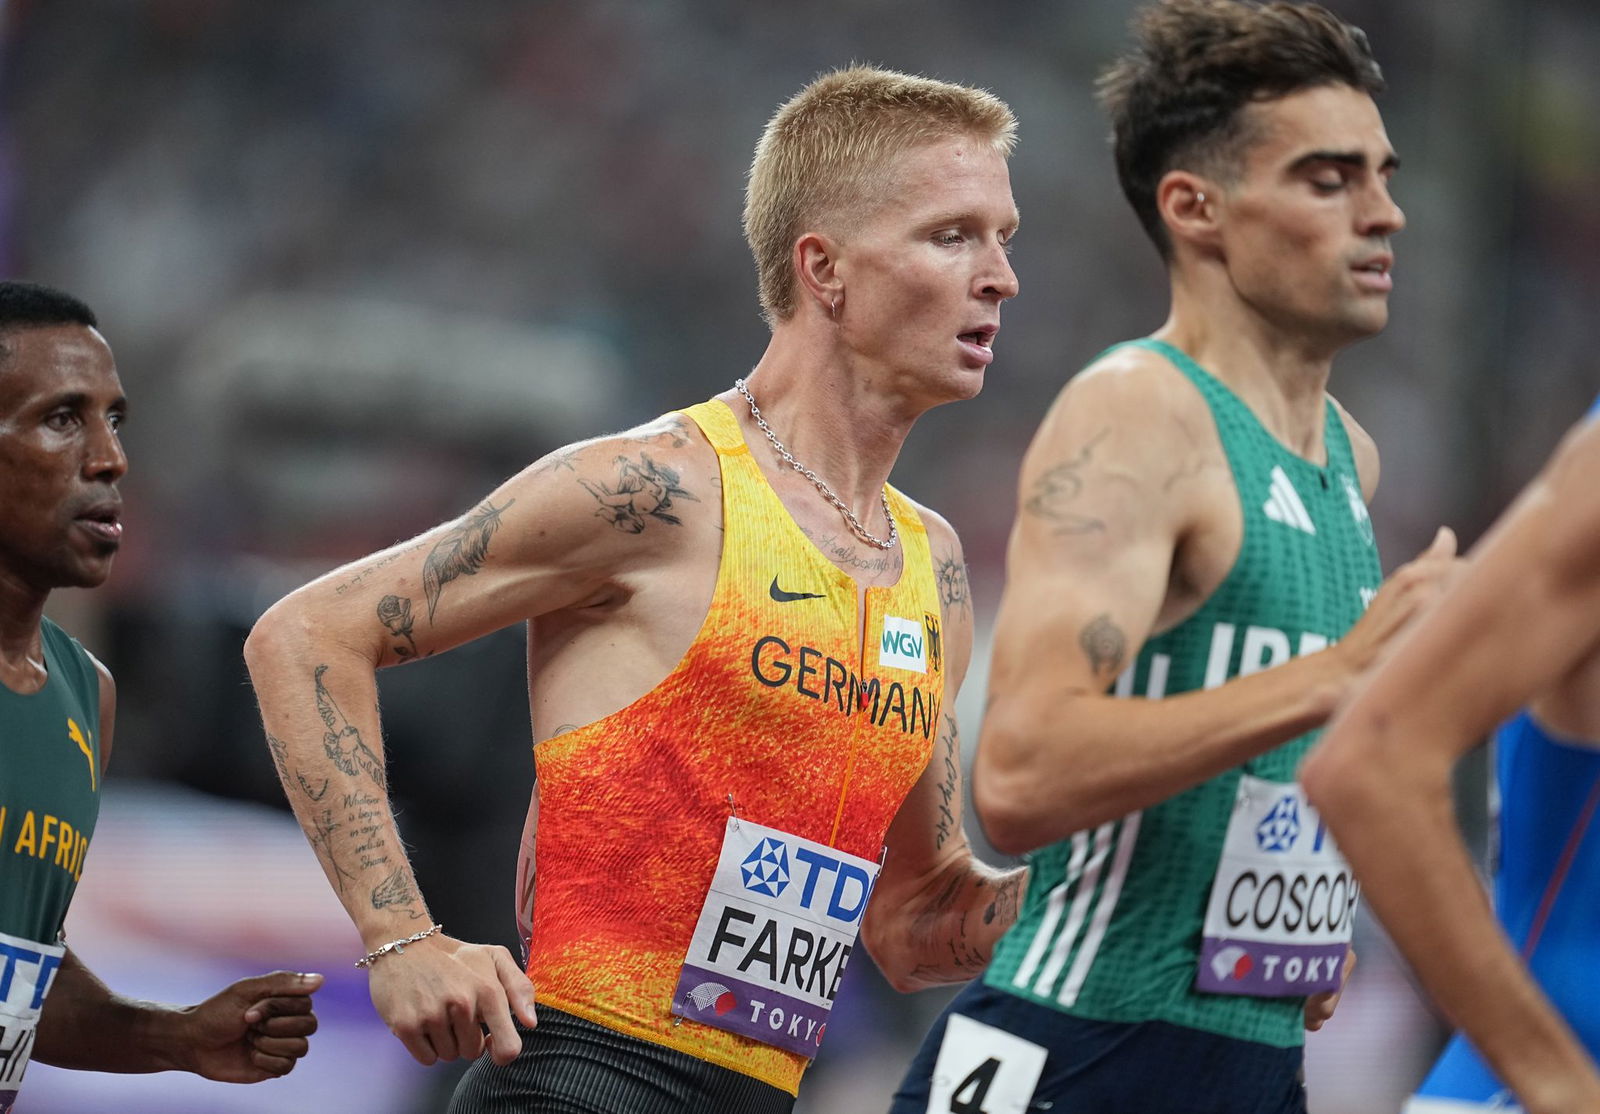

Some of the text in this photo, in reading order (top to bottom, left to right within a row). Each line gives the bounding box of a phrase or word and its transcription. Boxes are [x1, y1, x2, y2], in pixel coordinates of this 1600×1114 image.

[881, 630, 923, 661] WGV
[751, 636, 940, 745] GERMANY
[795, 847, 879, 927] TD
[1262, 954, 1341, 983] TOKY
[950, 1057, 1001, 1114] 4
